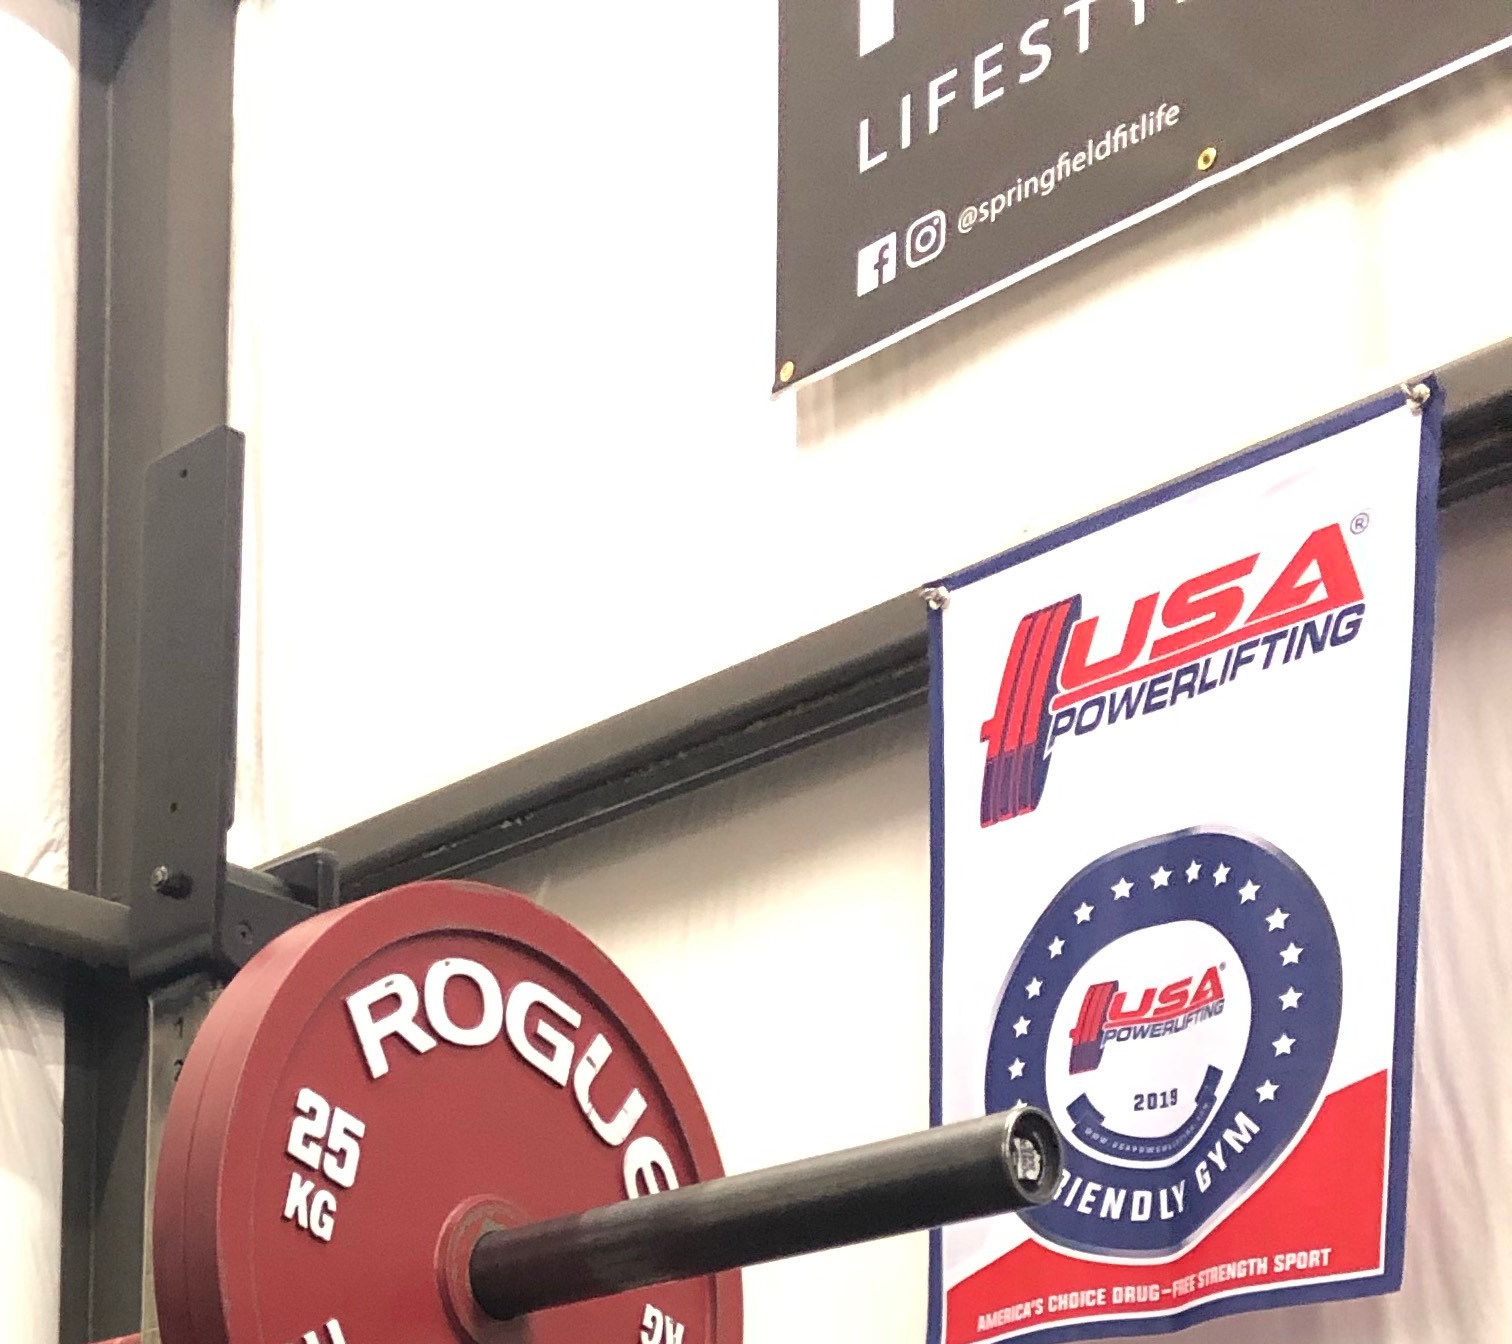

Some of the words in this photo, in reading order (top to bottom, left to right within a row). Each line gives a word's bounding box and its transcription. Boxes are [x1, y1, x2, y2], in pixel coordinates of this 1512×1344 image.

[859, 0, 1185, 174] LIFEST
[957, 102, 1181, 234] @springfieldfitlife
[1059, 522, 1364, 691] USA
[1047, 602, 1366, 751] POWERLIFTING
[1101, 998, 1226, 1046] POWERLIFTING
[1107, 965, 1225, 1022] USA
[287, 1087, 366, 1191] 25
[1133, 1087, 1179, 1112] 2019
[282, 1170, 338, 1243] KG
[1053, 1168, 1186, 1222] IENDLY
[1194, 1110, 1261, 1193] GYM
[976, 1297, 1044, 1333] AMERICA'S
[1047, 1287, 1107, 1313] CHOICE
[1197, 1256, 1269, 1289] STRENGTH
[1273, 1247, 1332, 1273] SPORT
